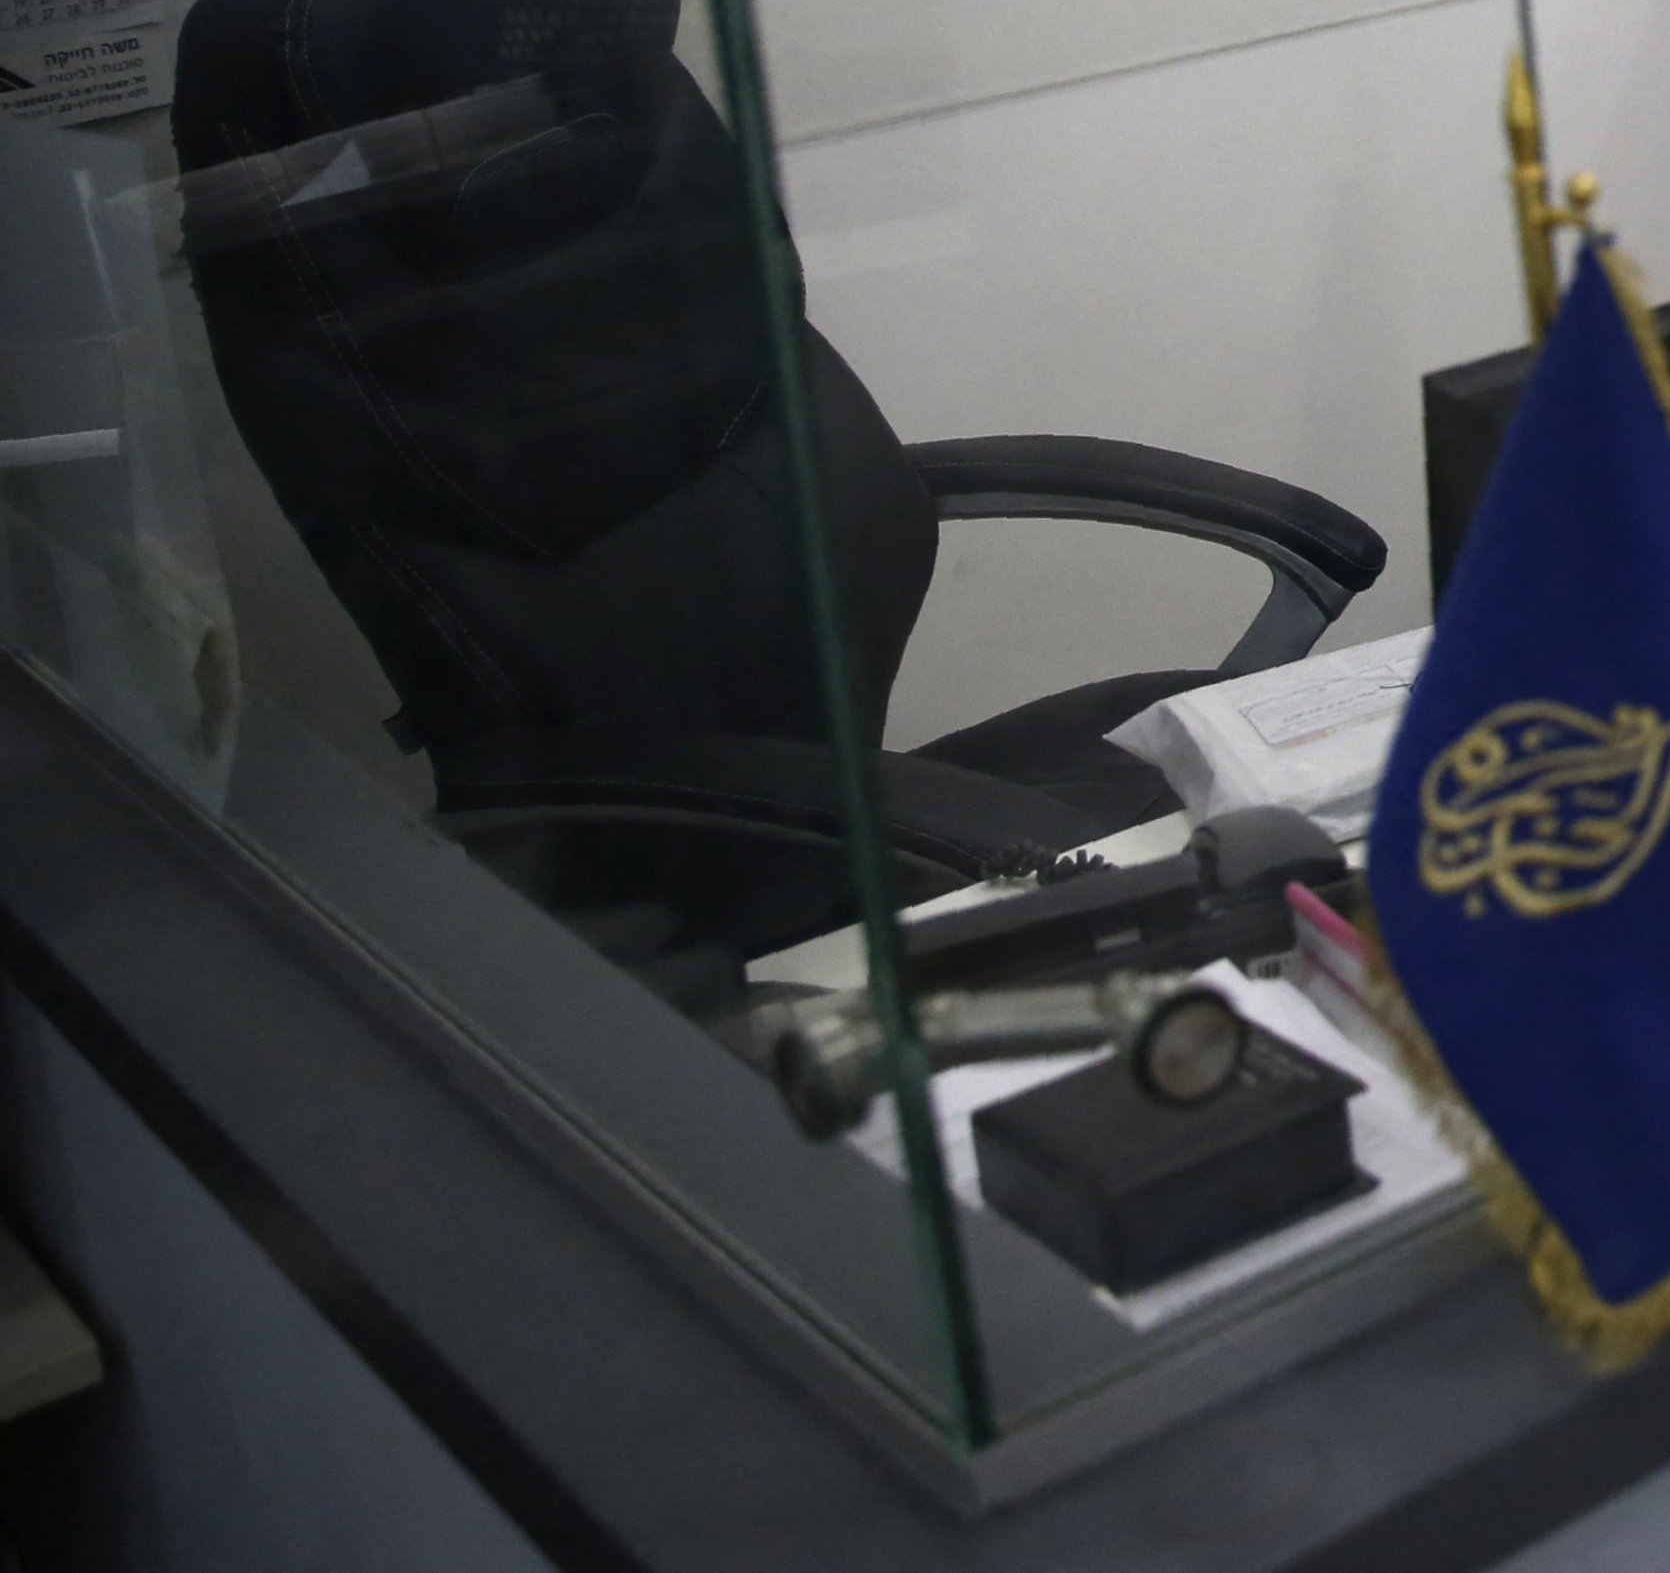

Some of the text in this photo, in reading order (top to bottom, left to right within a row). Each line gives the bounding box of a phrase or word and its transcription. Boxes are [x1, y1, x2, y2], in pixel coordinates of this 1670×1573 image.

[43, 36, 141, 70] משה חייקה
[100, 56, 144, 74] סוכנות
